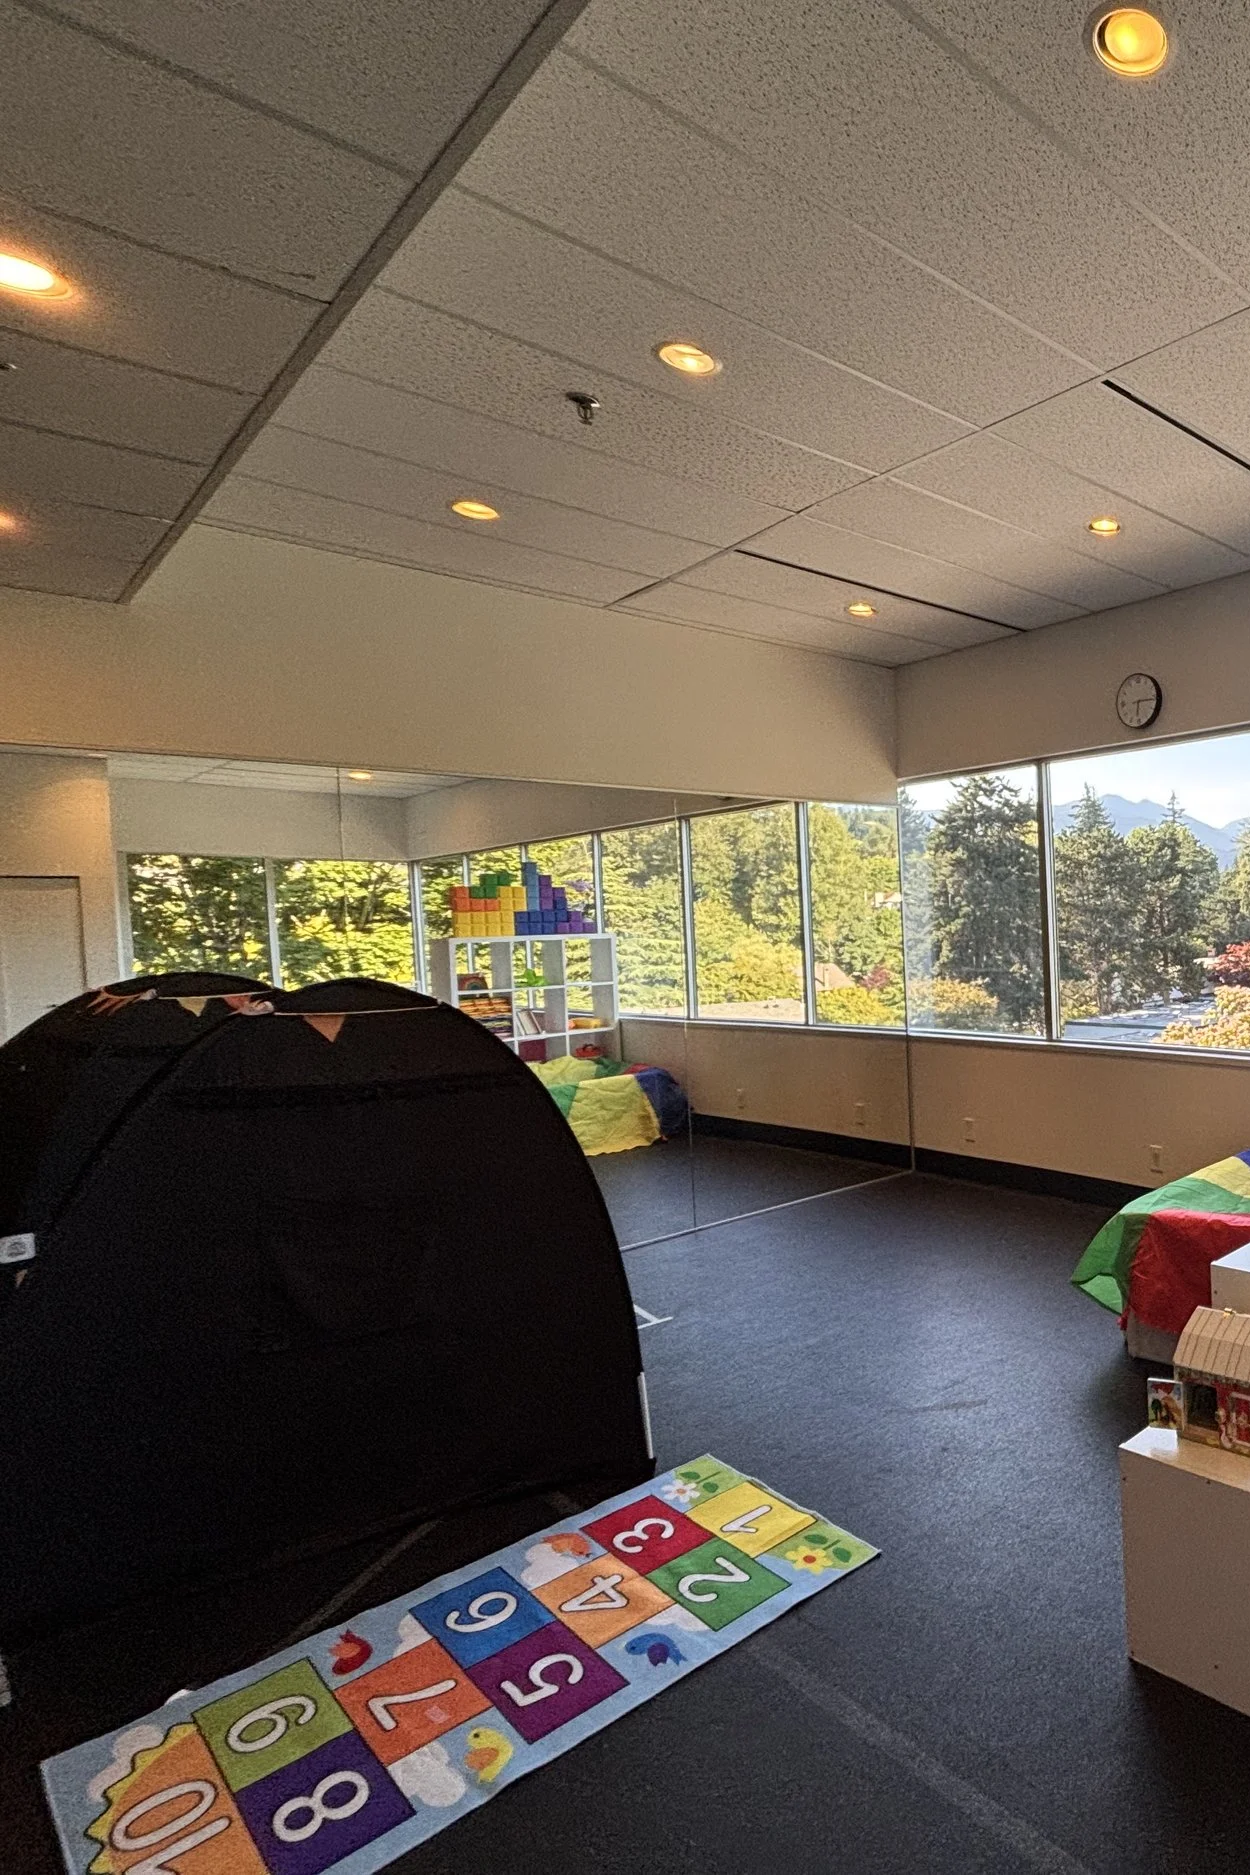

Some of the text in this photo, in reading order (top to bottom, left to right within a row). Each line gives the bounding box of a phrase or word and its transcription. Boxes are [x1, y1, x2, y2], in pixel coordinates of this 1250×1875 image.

[612, 1517, 674, 1553] 3
[720, 1504, 773, 1534] 1
[559, 1573, 629, 1613] 4
[678, 1556, 751, 1602] 2
[445, 1591, 518, 1633] 6
[500, 1653, 585, 1707] 5
[226, 1695, 317, 1753] 9
[367, 1679, 457, 1731] 7
[109, 1779, 232, 1875] 10
[272, 1770, 370, 1843] 8
